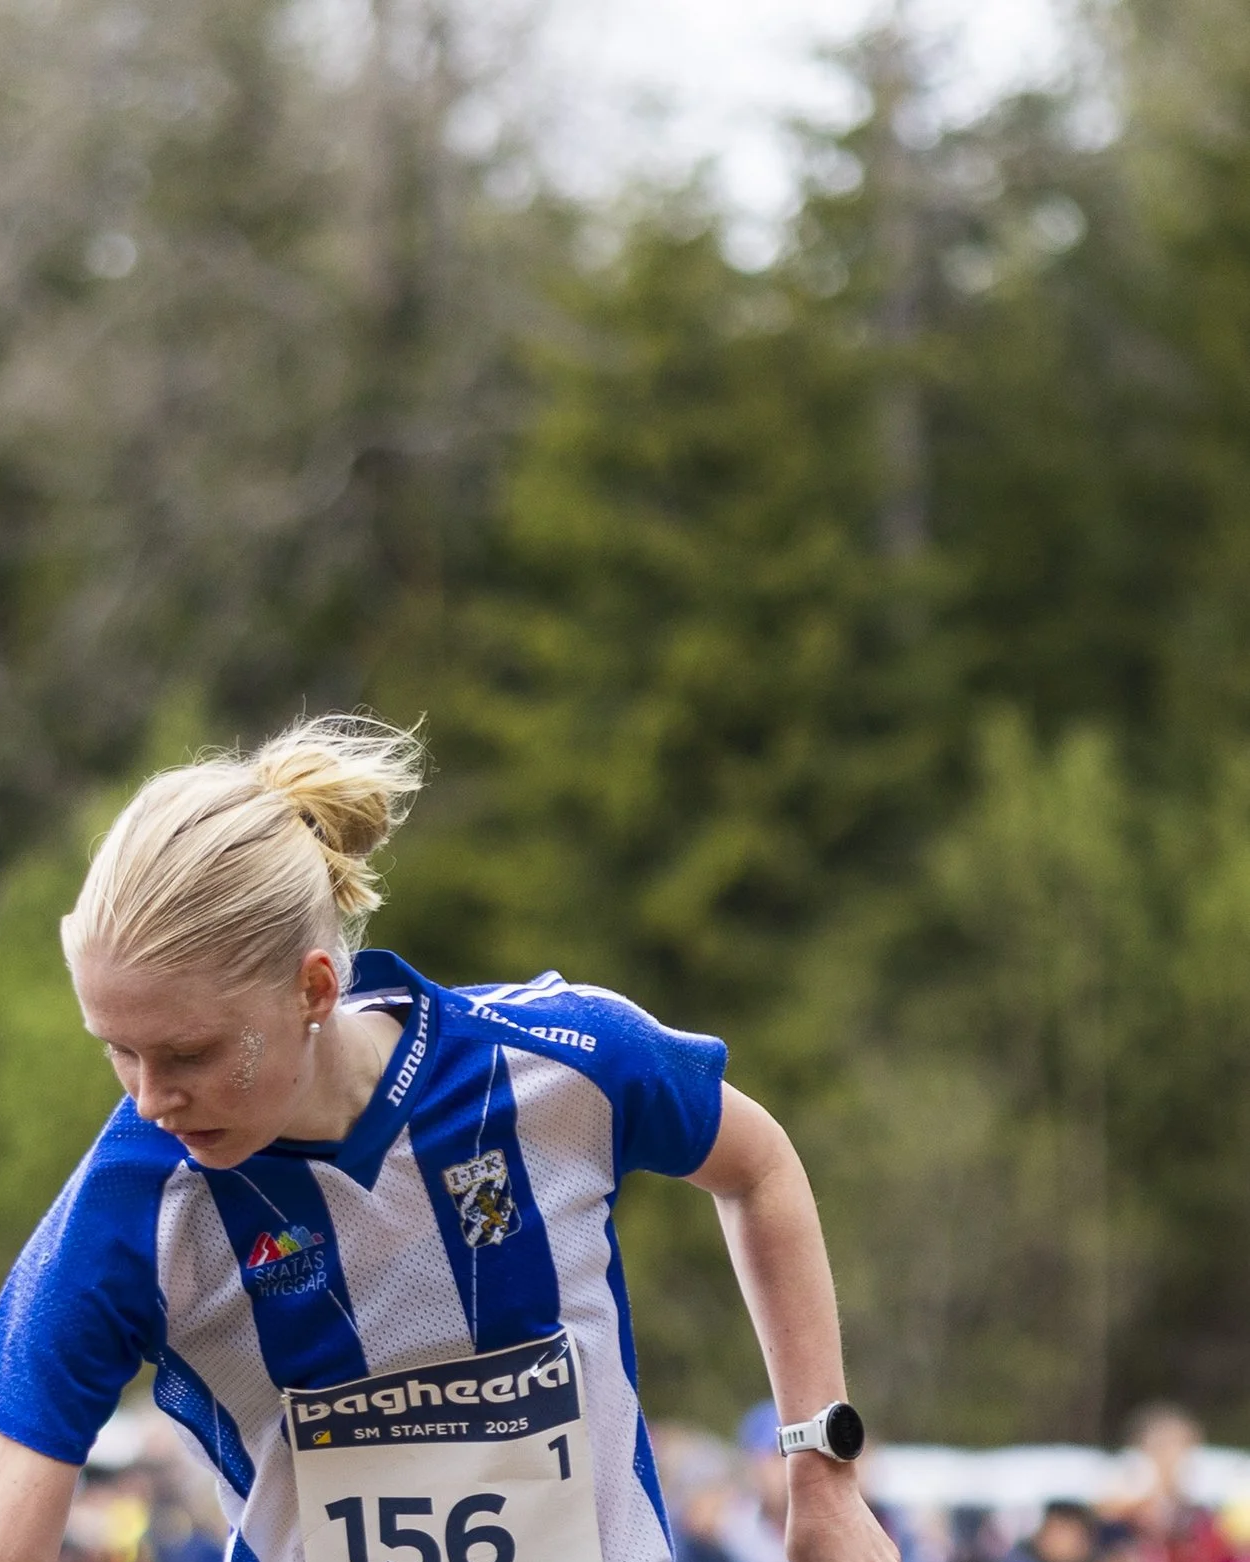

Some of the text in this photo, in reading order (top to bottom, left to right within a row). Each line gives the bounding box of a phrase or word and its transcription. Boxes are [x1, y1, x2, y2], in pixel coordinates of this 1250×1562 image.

[386, 993, 431, 1107] noname
[354, 1417, 529, 1440] SM STAFETT 2025
[547, 1433, 572, 1481] 1
